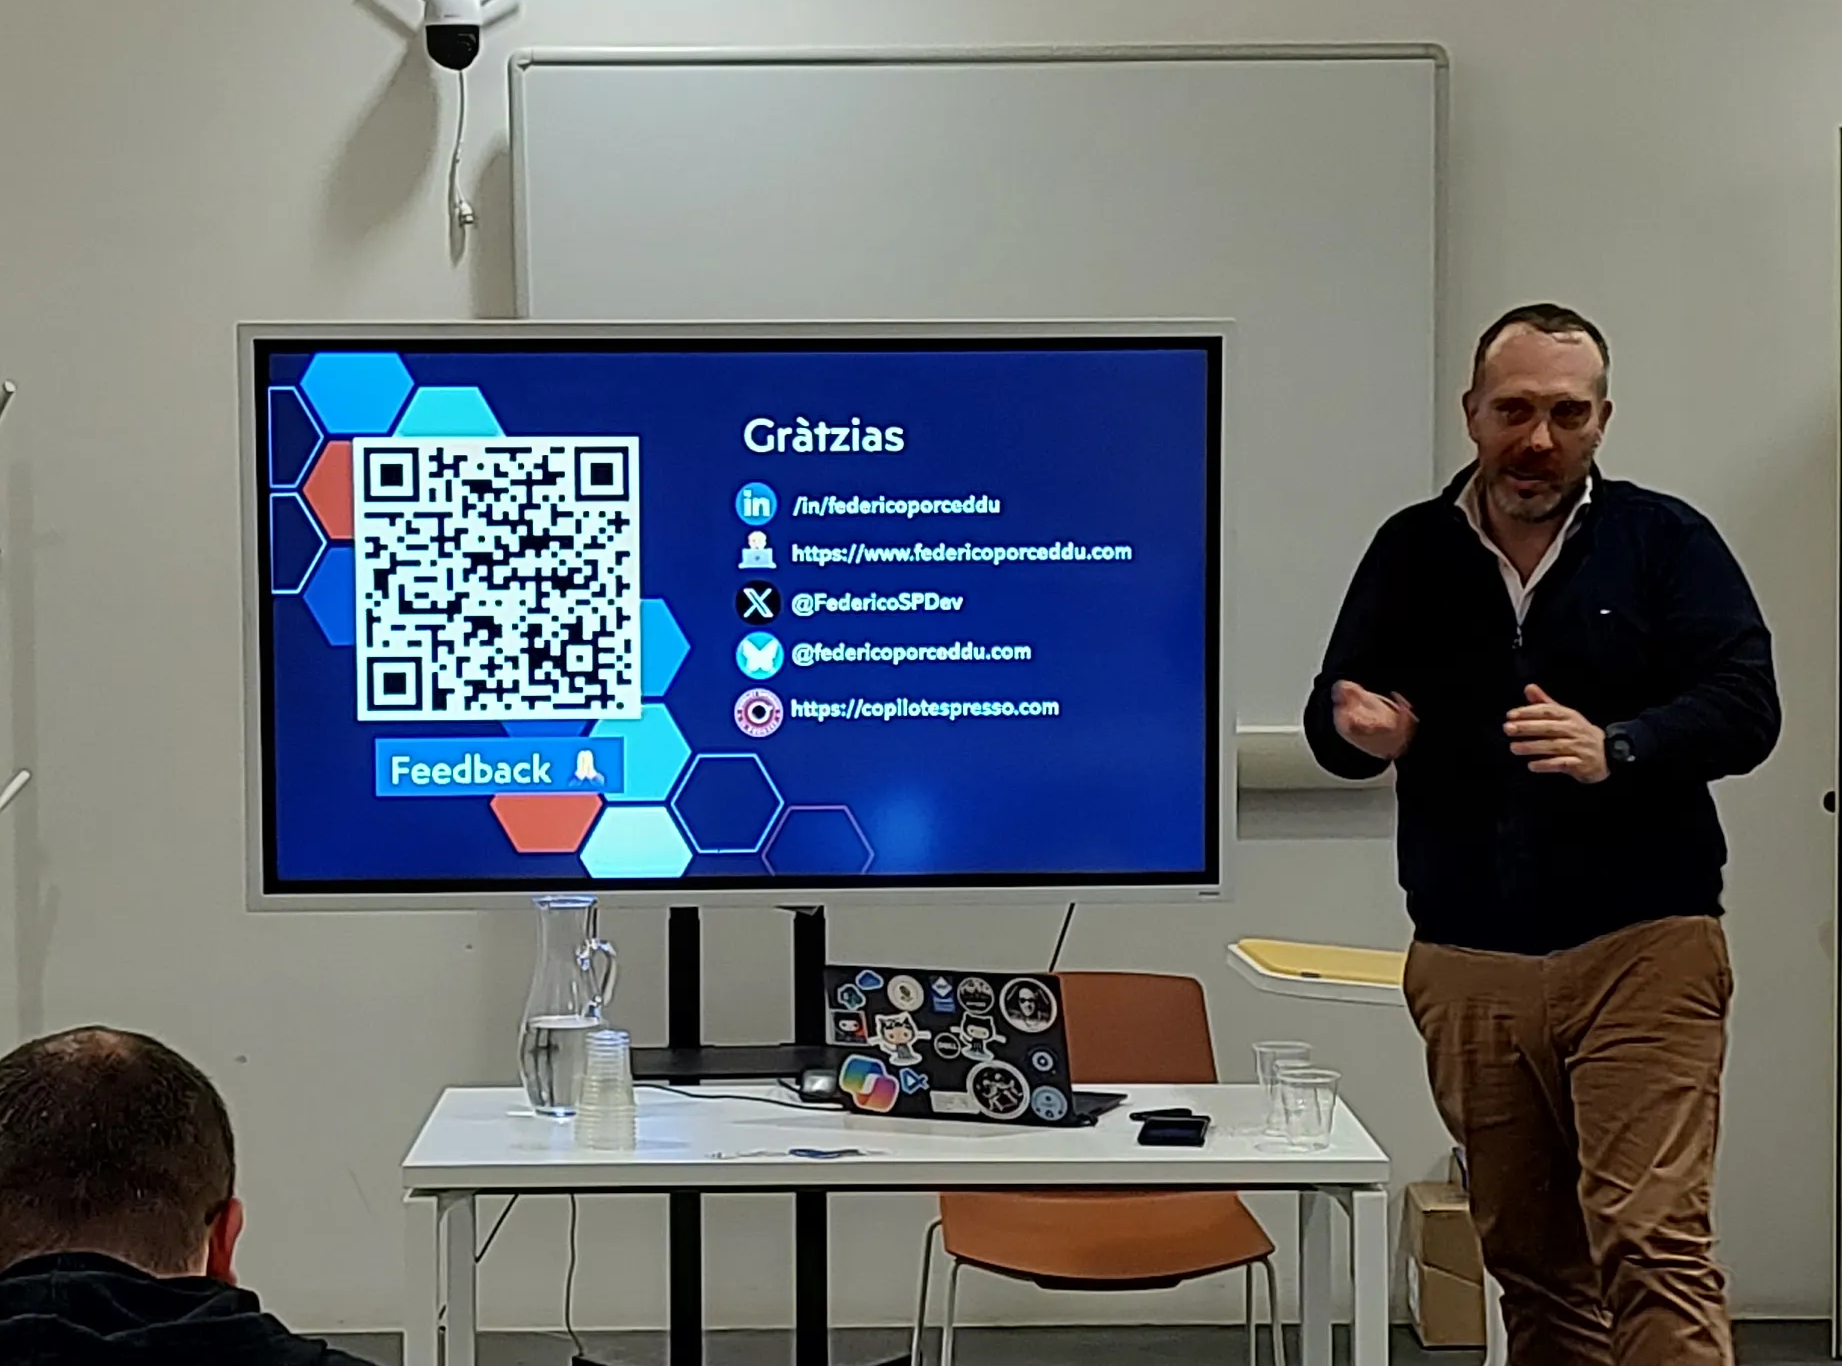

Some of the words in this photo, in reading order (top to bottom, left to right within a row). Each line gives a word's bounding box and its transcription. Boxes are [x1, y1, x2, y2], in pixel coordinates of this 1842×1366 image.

[743, 416, 905, 453] Gràtzias
[792, 494, 1001, 519] /in/federicoporceddu
[791, 541, 1132, 567] https://www.federicoporceddu.com
[791, 592, 964, 617] @FedericoSPDev
[791, 641, 1032, 667] @federicoporceddu.com
[790, 697, 1060, 723] https://copilotespresso.com
[391, 753, 552, 785] Feedback
